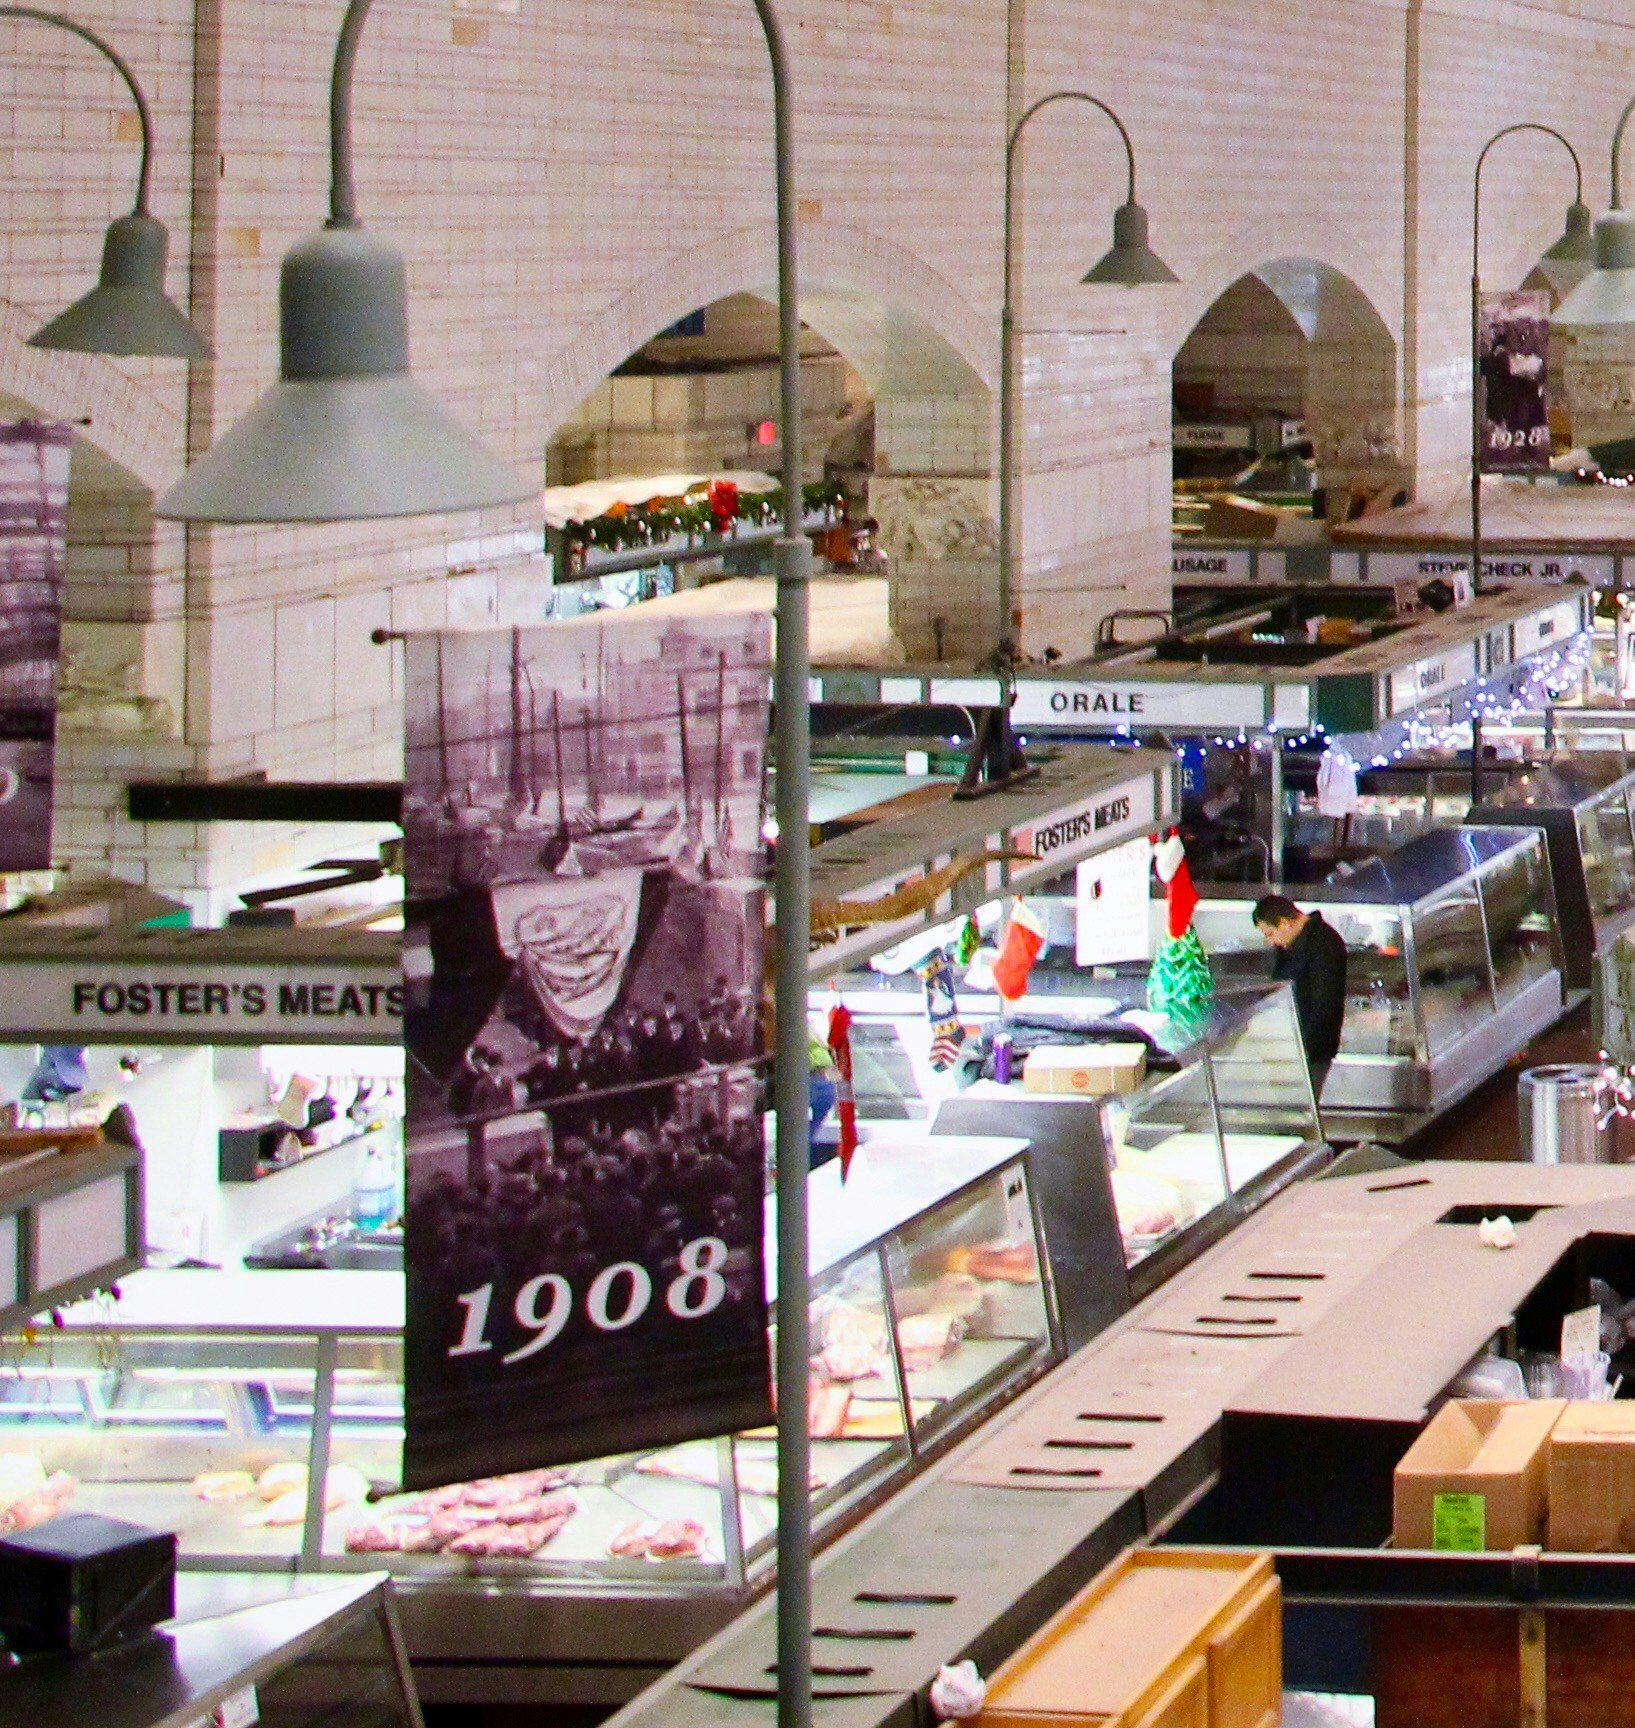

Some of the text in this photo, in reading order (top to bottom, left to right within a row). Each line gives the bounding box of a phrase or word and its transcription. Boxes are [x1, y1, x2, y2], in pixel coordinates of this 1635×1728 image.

[1173, 557, 1228, 573] USAGE
[1050, 692, 1144, 714] ORALE
[1035, 810, 1091, 856] FOSTER'S
[1094, 794, 1130, 831] MEATS
[72, 982, 405, 1020] FOSTER'S MEATS
[446, 1235, 729, 1366] 1908
